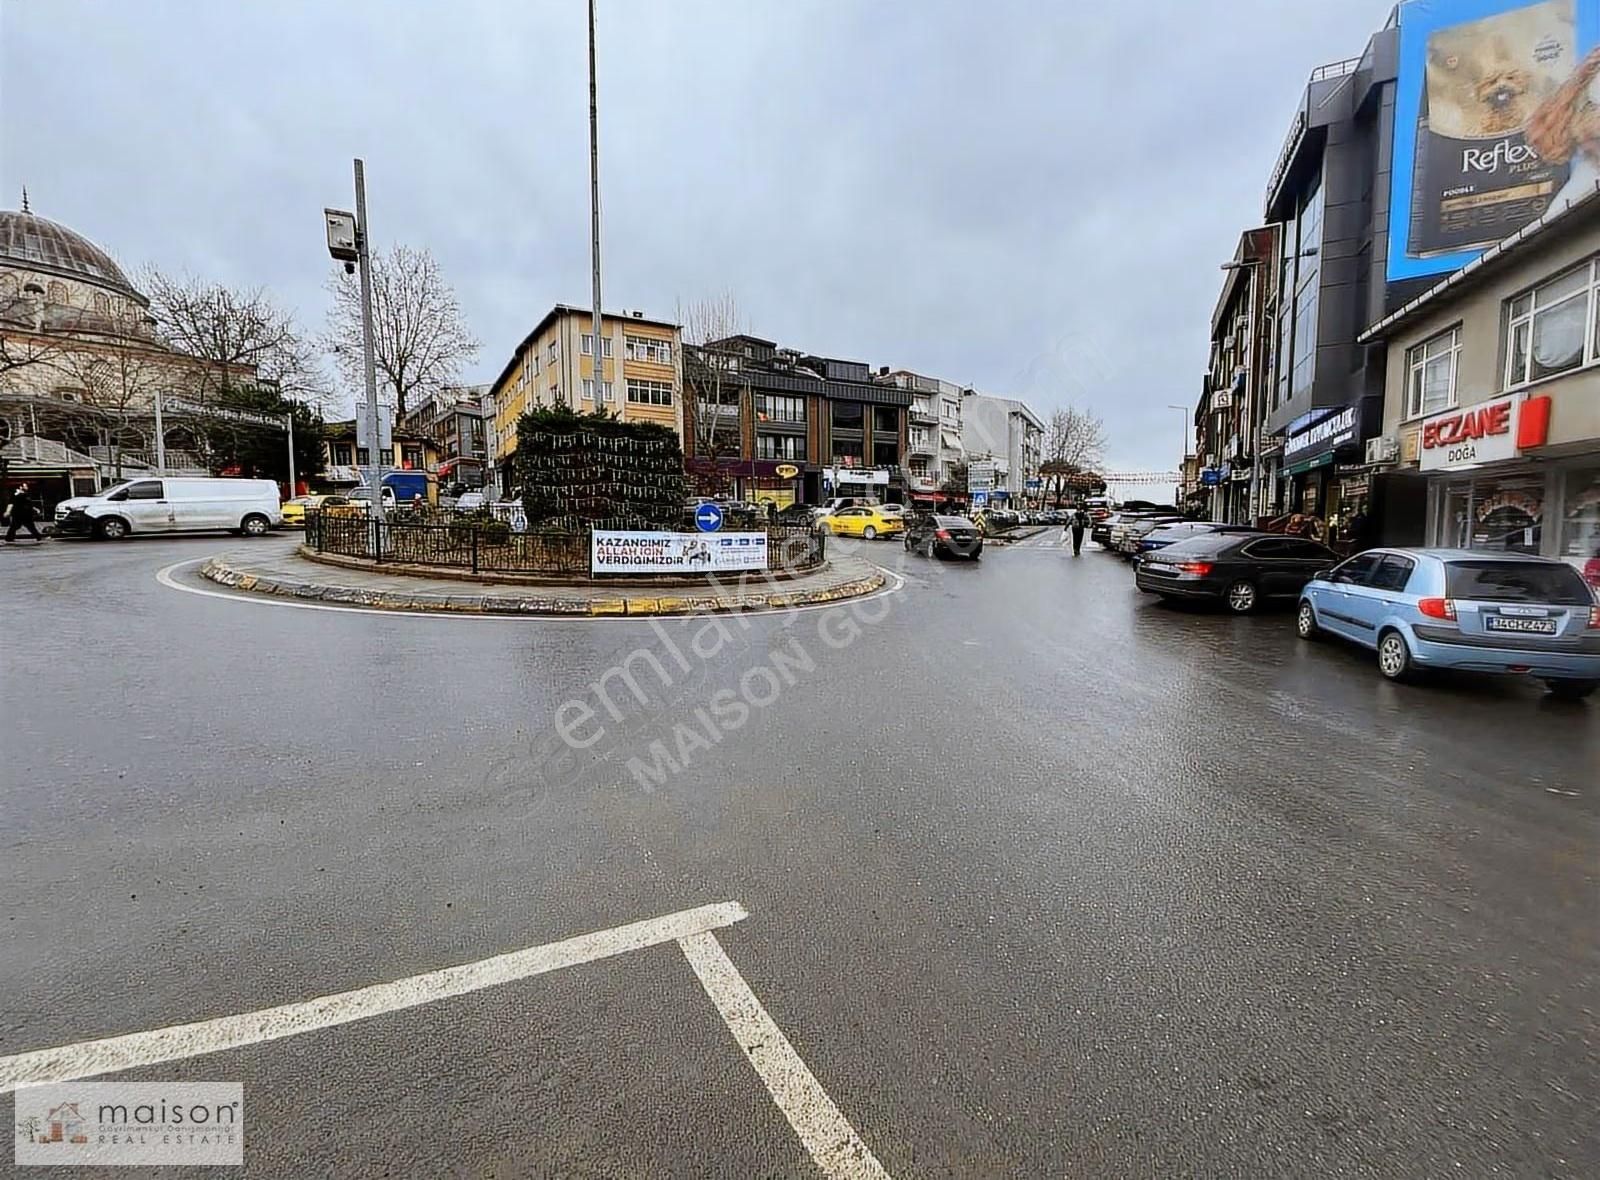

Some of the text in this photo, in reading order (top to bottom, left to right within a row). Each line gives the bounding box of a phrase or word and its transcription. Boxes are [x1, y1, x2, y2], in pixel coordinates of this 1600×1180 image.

[1461, 139, 1539, 174] Reflex
[1423, 401, 1511, 449] ECZANE
[1448, 444, 1476, 462] DOĞA
[596, 547, 636, 556] ALLAH
